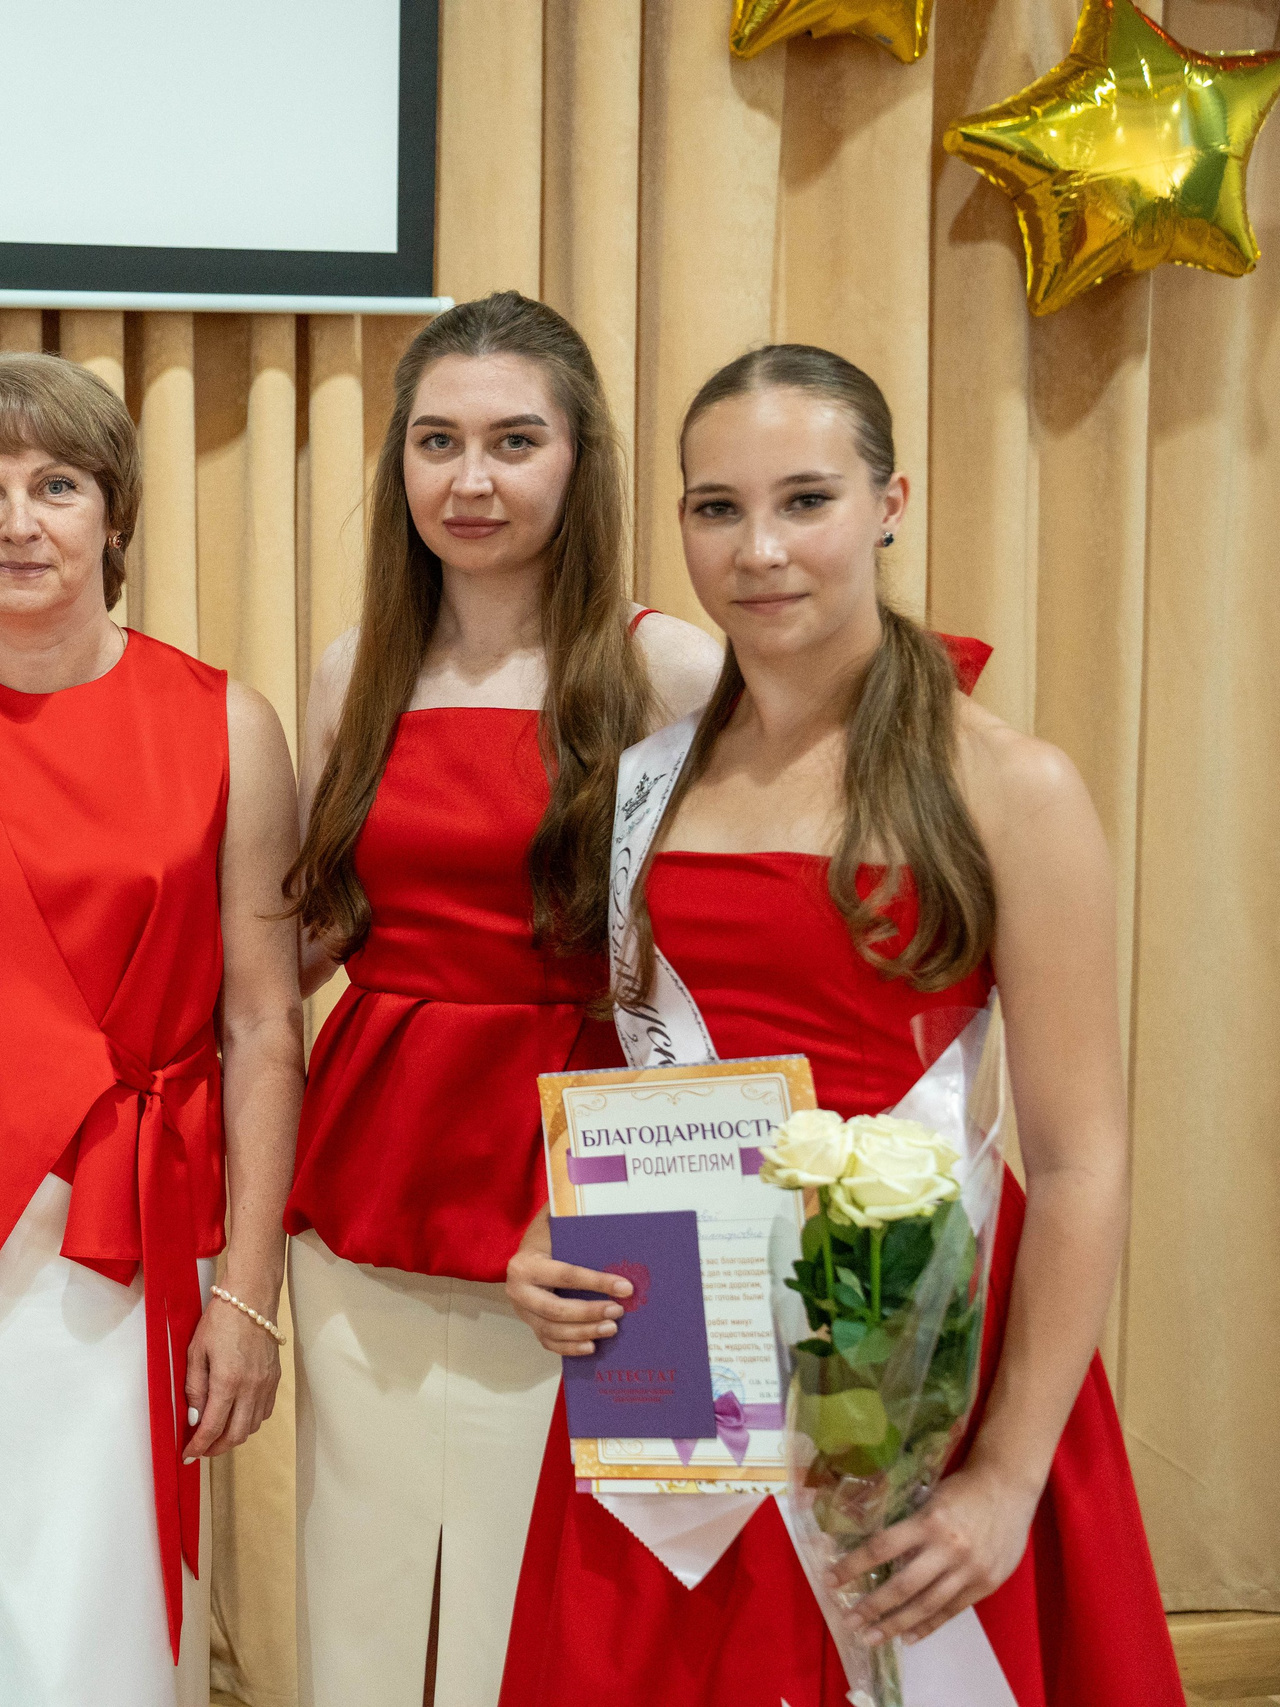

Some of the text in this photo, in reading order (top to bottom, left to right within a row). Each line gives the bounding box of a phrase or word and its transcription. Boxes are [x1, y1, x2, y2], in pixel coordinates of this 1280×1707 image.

[631, 1153, 735, 1177] РОДИТЕЛЯМ
[720, 1256, 765, 1266] благодарим
[595, 1368, 677, 1383] АТТЕСТАТ
